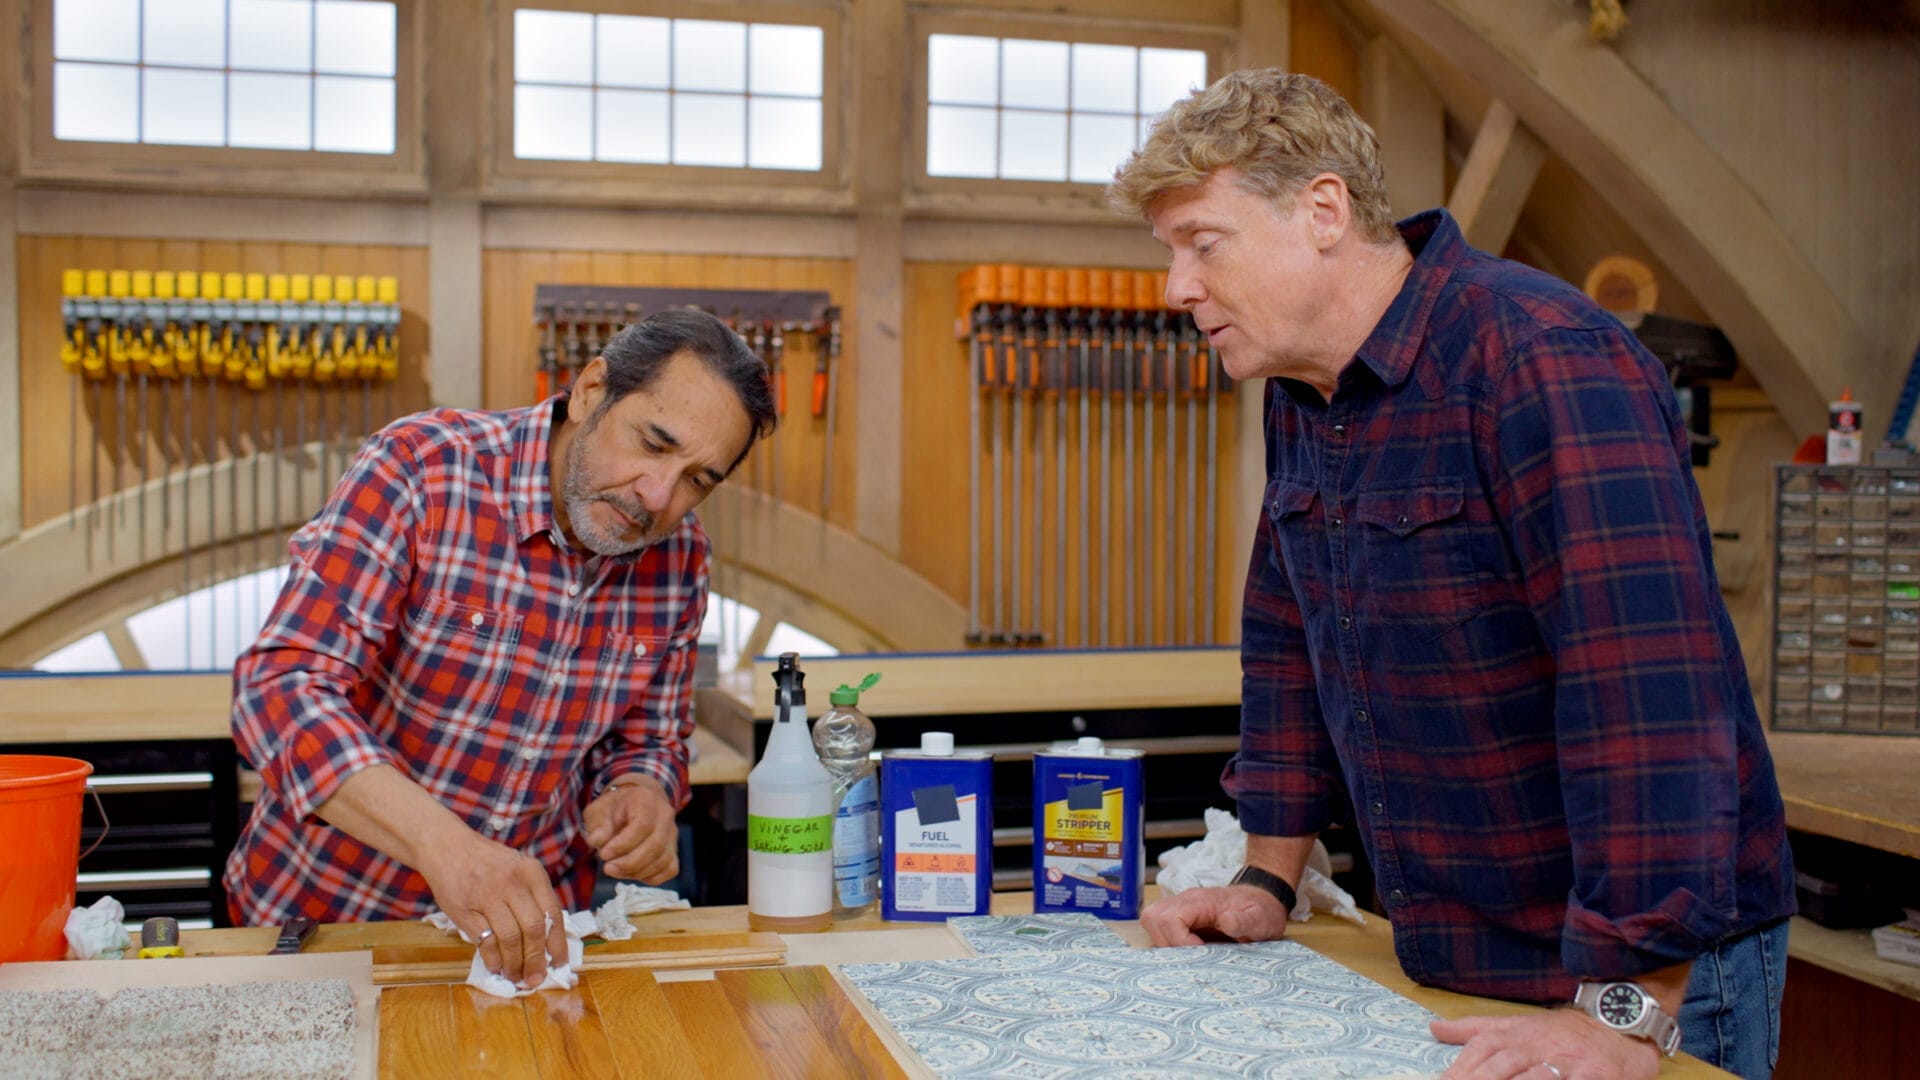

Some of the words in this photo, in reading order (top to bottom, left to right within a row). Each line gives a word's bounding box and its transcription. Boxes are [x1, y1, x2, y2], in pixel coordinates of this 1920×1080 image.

[760, 822, 819, 834] VINEGAR
[1057, 819, 1111, 830] STRIPPER
[921, 832, 949, 841] FUEL
[799, 842, 824, 854] SODA
